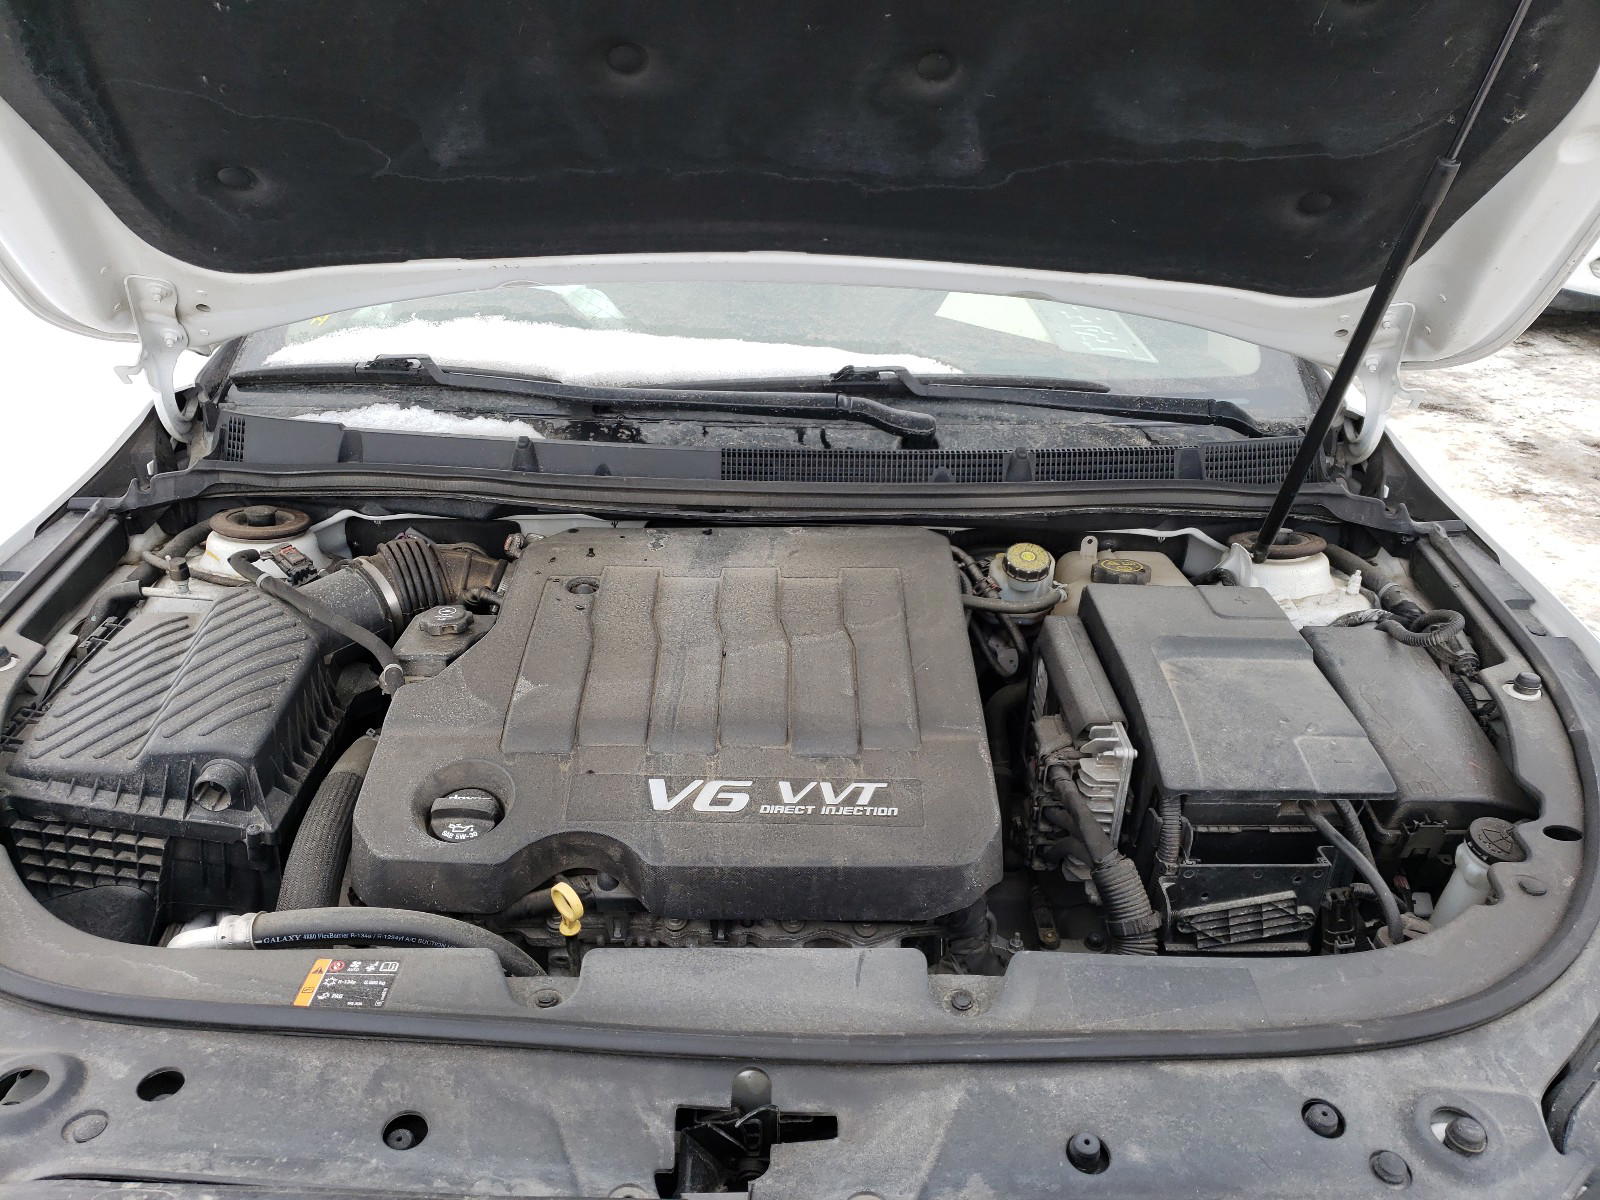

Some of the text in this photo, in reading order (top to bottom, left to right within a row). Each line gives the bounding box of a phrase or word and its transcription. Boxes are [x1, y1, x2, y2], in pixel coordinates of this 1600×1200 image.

[648, 778, 889, 812] V6 VVT
[760, 804, 898, 816] DIRECT INJECTION
[263, 934, 301, 944] GALAXY
